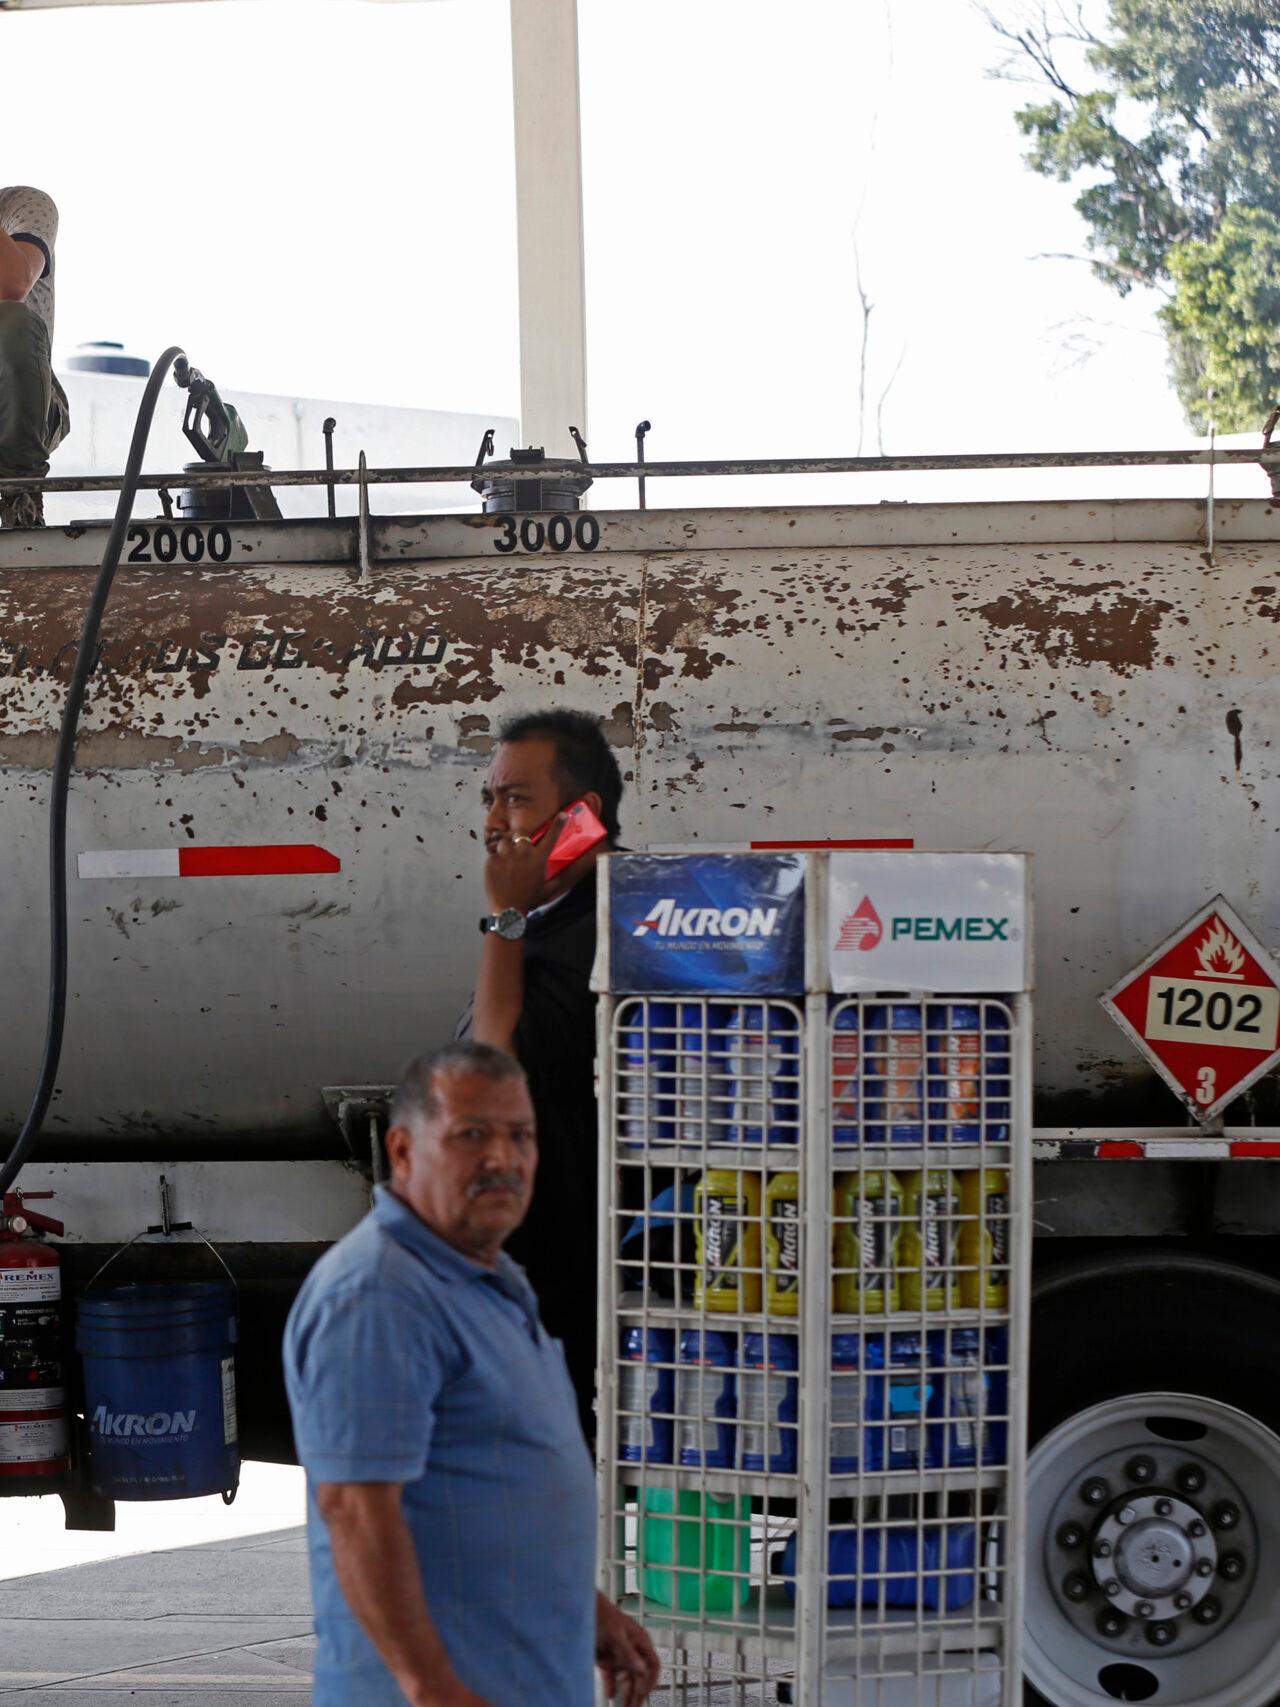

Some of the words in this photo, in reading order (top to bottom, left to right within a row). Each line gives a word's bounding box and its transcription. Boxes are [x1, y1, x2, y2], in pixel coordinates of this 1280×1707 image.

[126, 525, 231, 562] 2000
[493, 514, 600, 552] 3000
[632, 898, 779, 937] AKRON
[891, 917, 1009, 941] PEMEX
[1157, 986, 1262, 1033] 1202
[1195, 1066, 1216, 1105] 3
[4, 1272, 54, 1281] REMEX
[90, 1405, 196, 1436] AKRON
